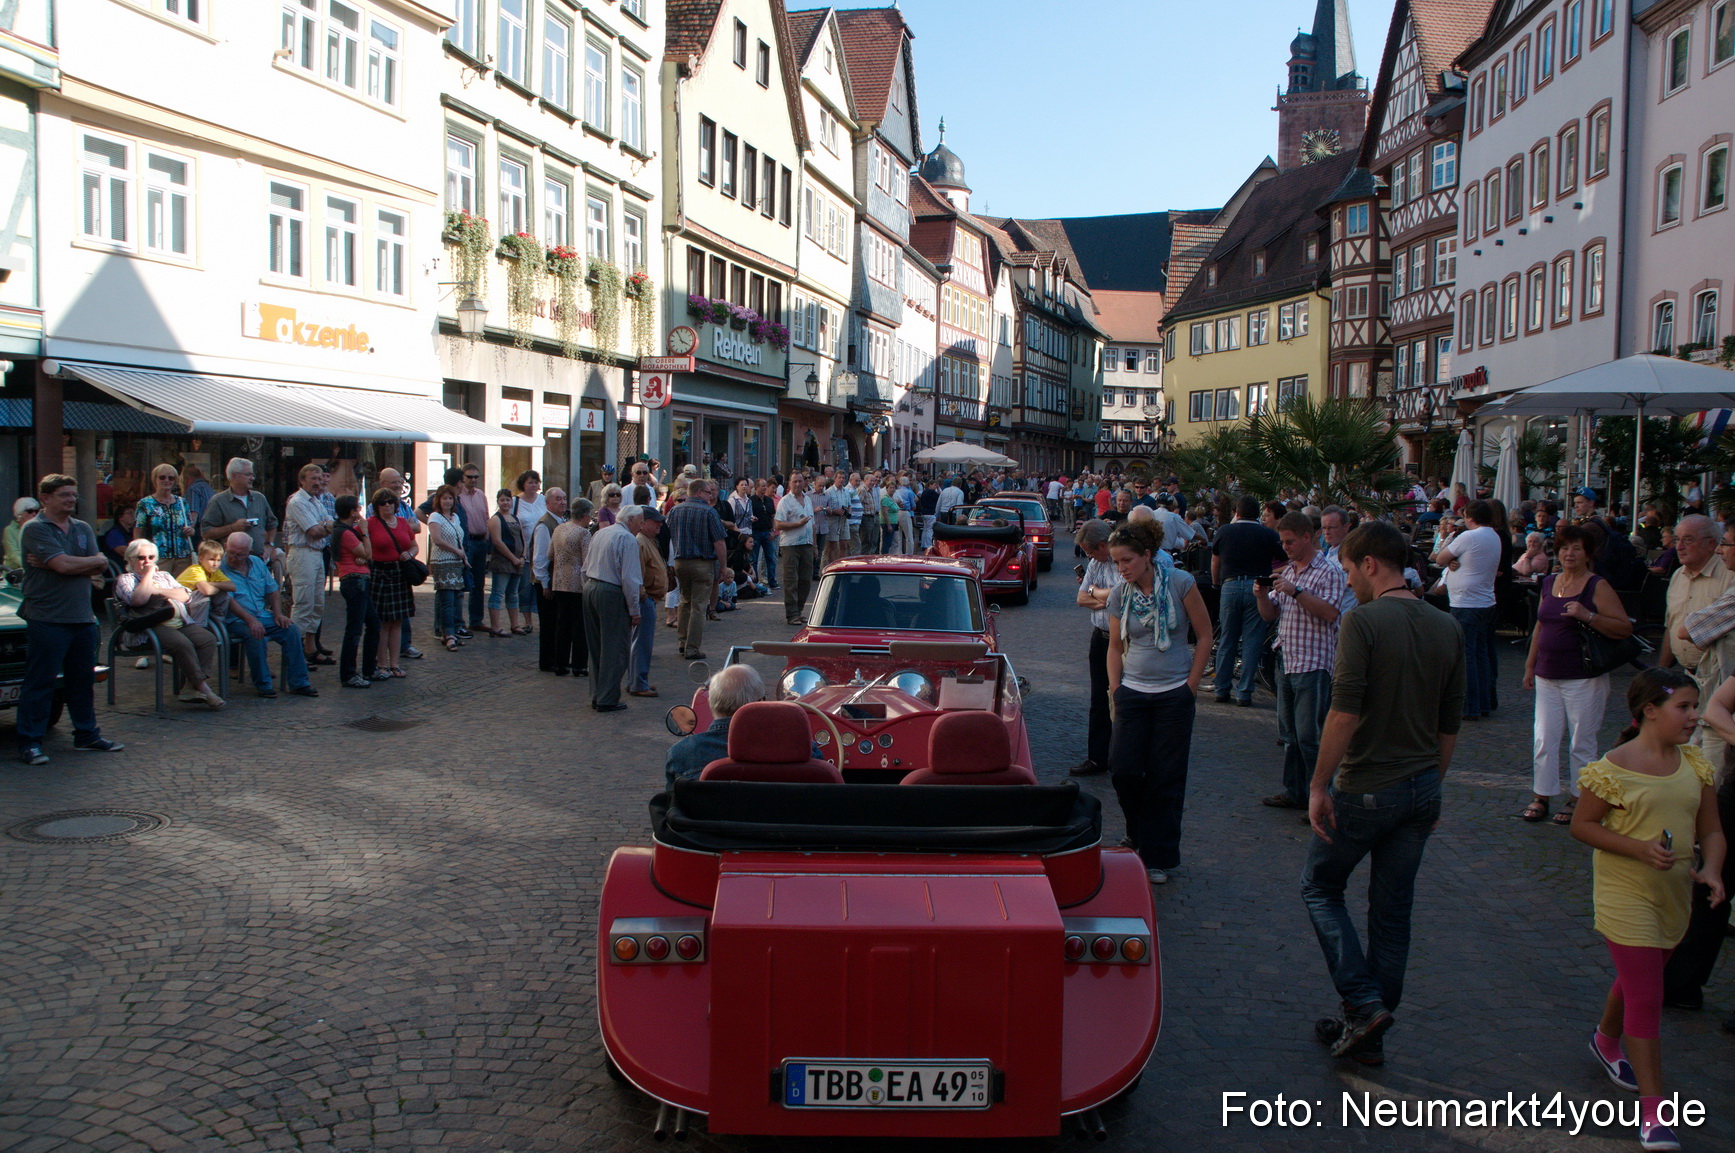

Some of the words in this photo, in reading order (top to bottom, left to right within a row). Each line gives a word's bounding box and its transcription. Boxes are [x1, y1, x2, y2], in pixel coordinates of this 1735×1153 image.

[712, 326, 762, 366] Rehbein
[808, 1069, 863, 1101] TBB
[887, 1070, 924, 1102] EA
[932, 1071, 968, 1102] 49
[970, 1071, 985, 1080] 05
[971, 1091, 985, 1101] 10
